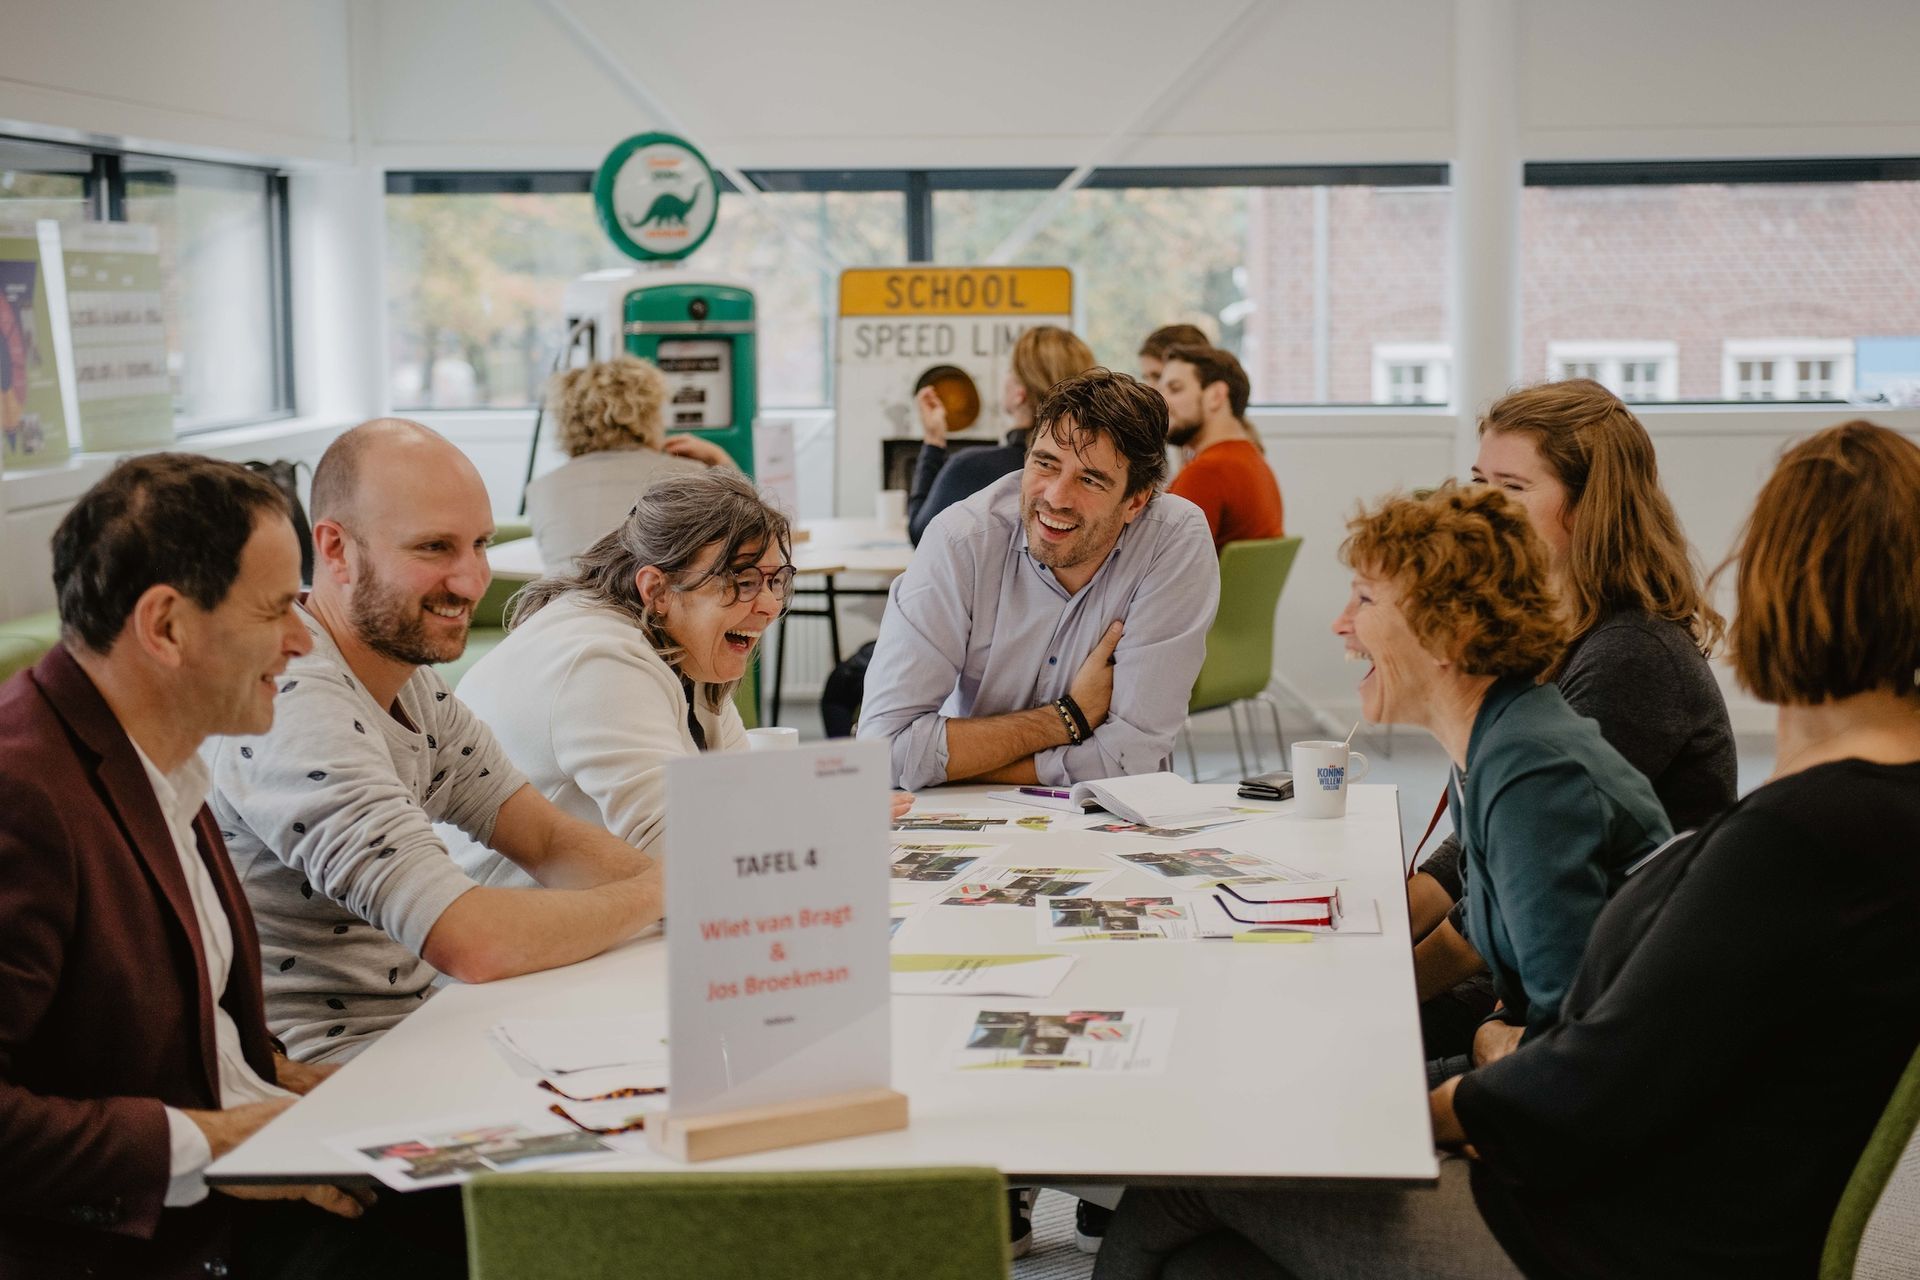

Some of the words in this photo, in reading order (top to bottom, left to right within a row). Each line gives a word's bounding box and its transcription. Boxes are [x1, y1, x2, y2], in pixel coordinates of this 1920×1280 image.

[885, 274, 1025, 309] SCHOOL
[855, 322, 955, 358] SPEED
[971, 322, 1025, 358] LIM
[734, 851, 798, 878] TAFEL
[804, 848, 818, 869] 4
[700, 918, 750, 941] Wiet
[756, 914, 793, 934] van
[798, 904, 853, 930] Bragt
[769, 942, 786, 962] &
[706, 981, 738, 1002] Jos
[744, 964, 849, 996] Broekman
